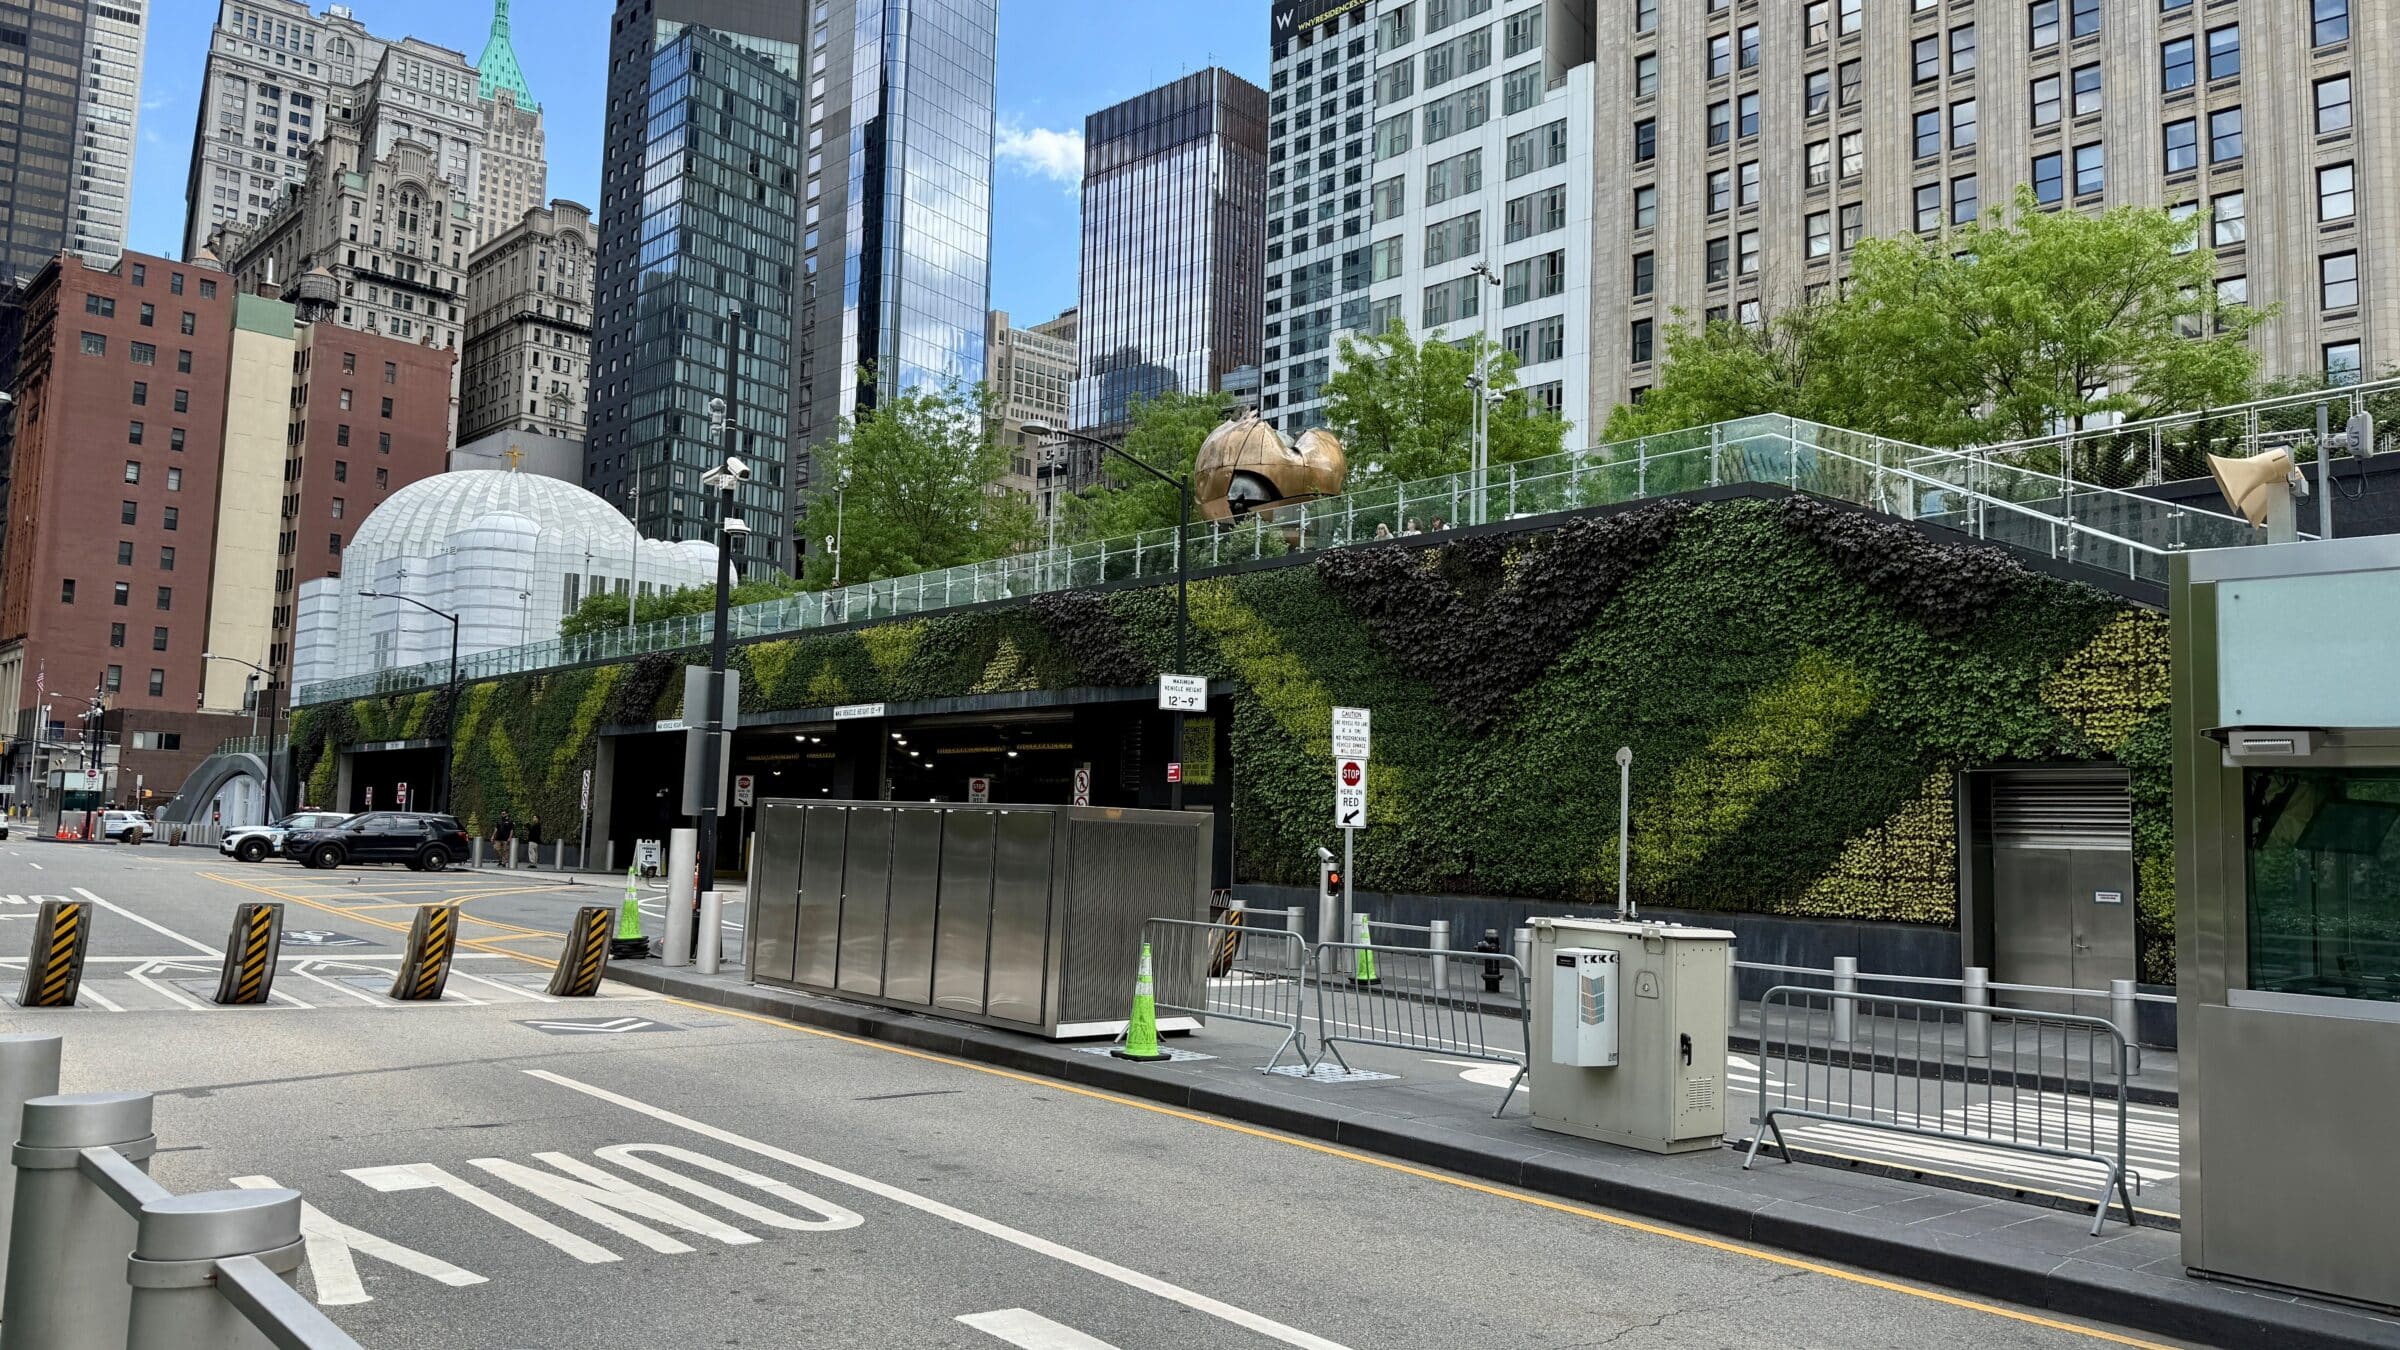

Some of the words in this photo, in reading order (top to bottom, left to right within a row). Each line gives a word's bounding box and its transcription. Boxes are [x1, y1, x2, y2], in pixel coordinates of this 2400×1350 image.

[1276, 9, 1294, 31] W
[1343, 769, 1360, 779] STOP
[1343, 797, 1359, 807] RED
